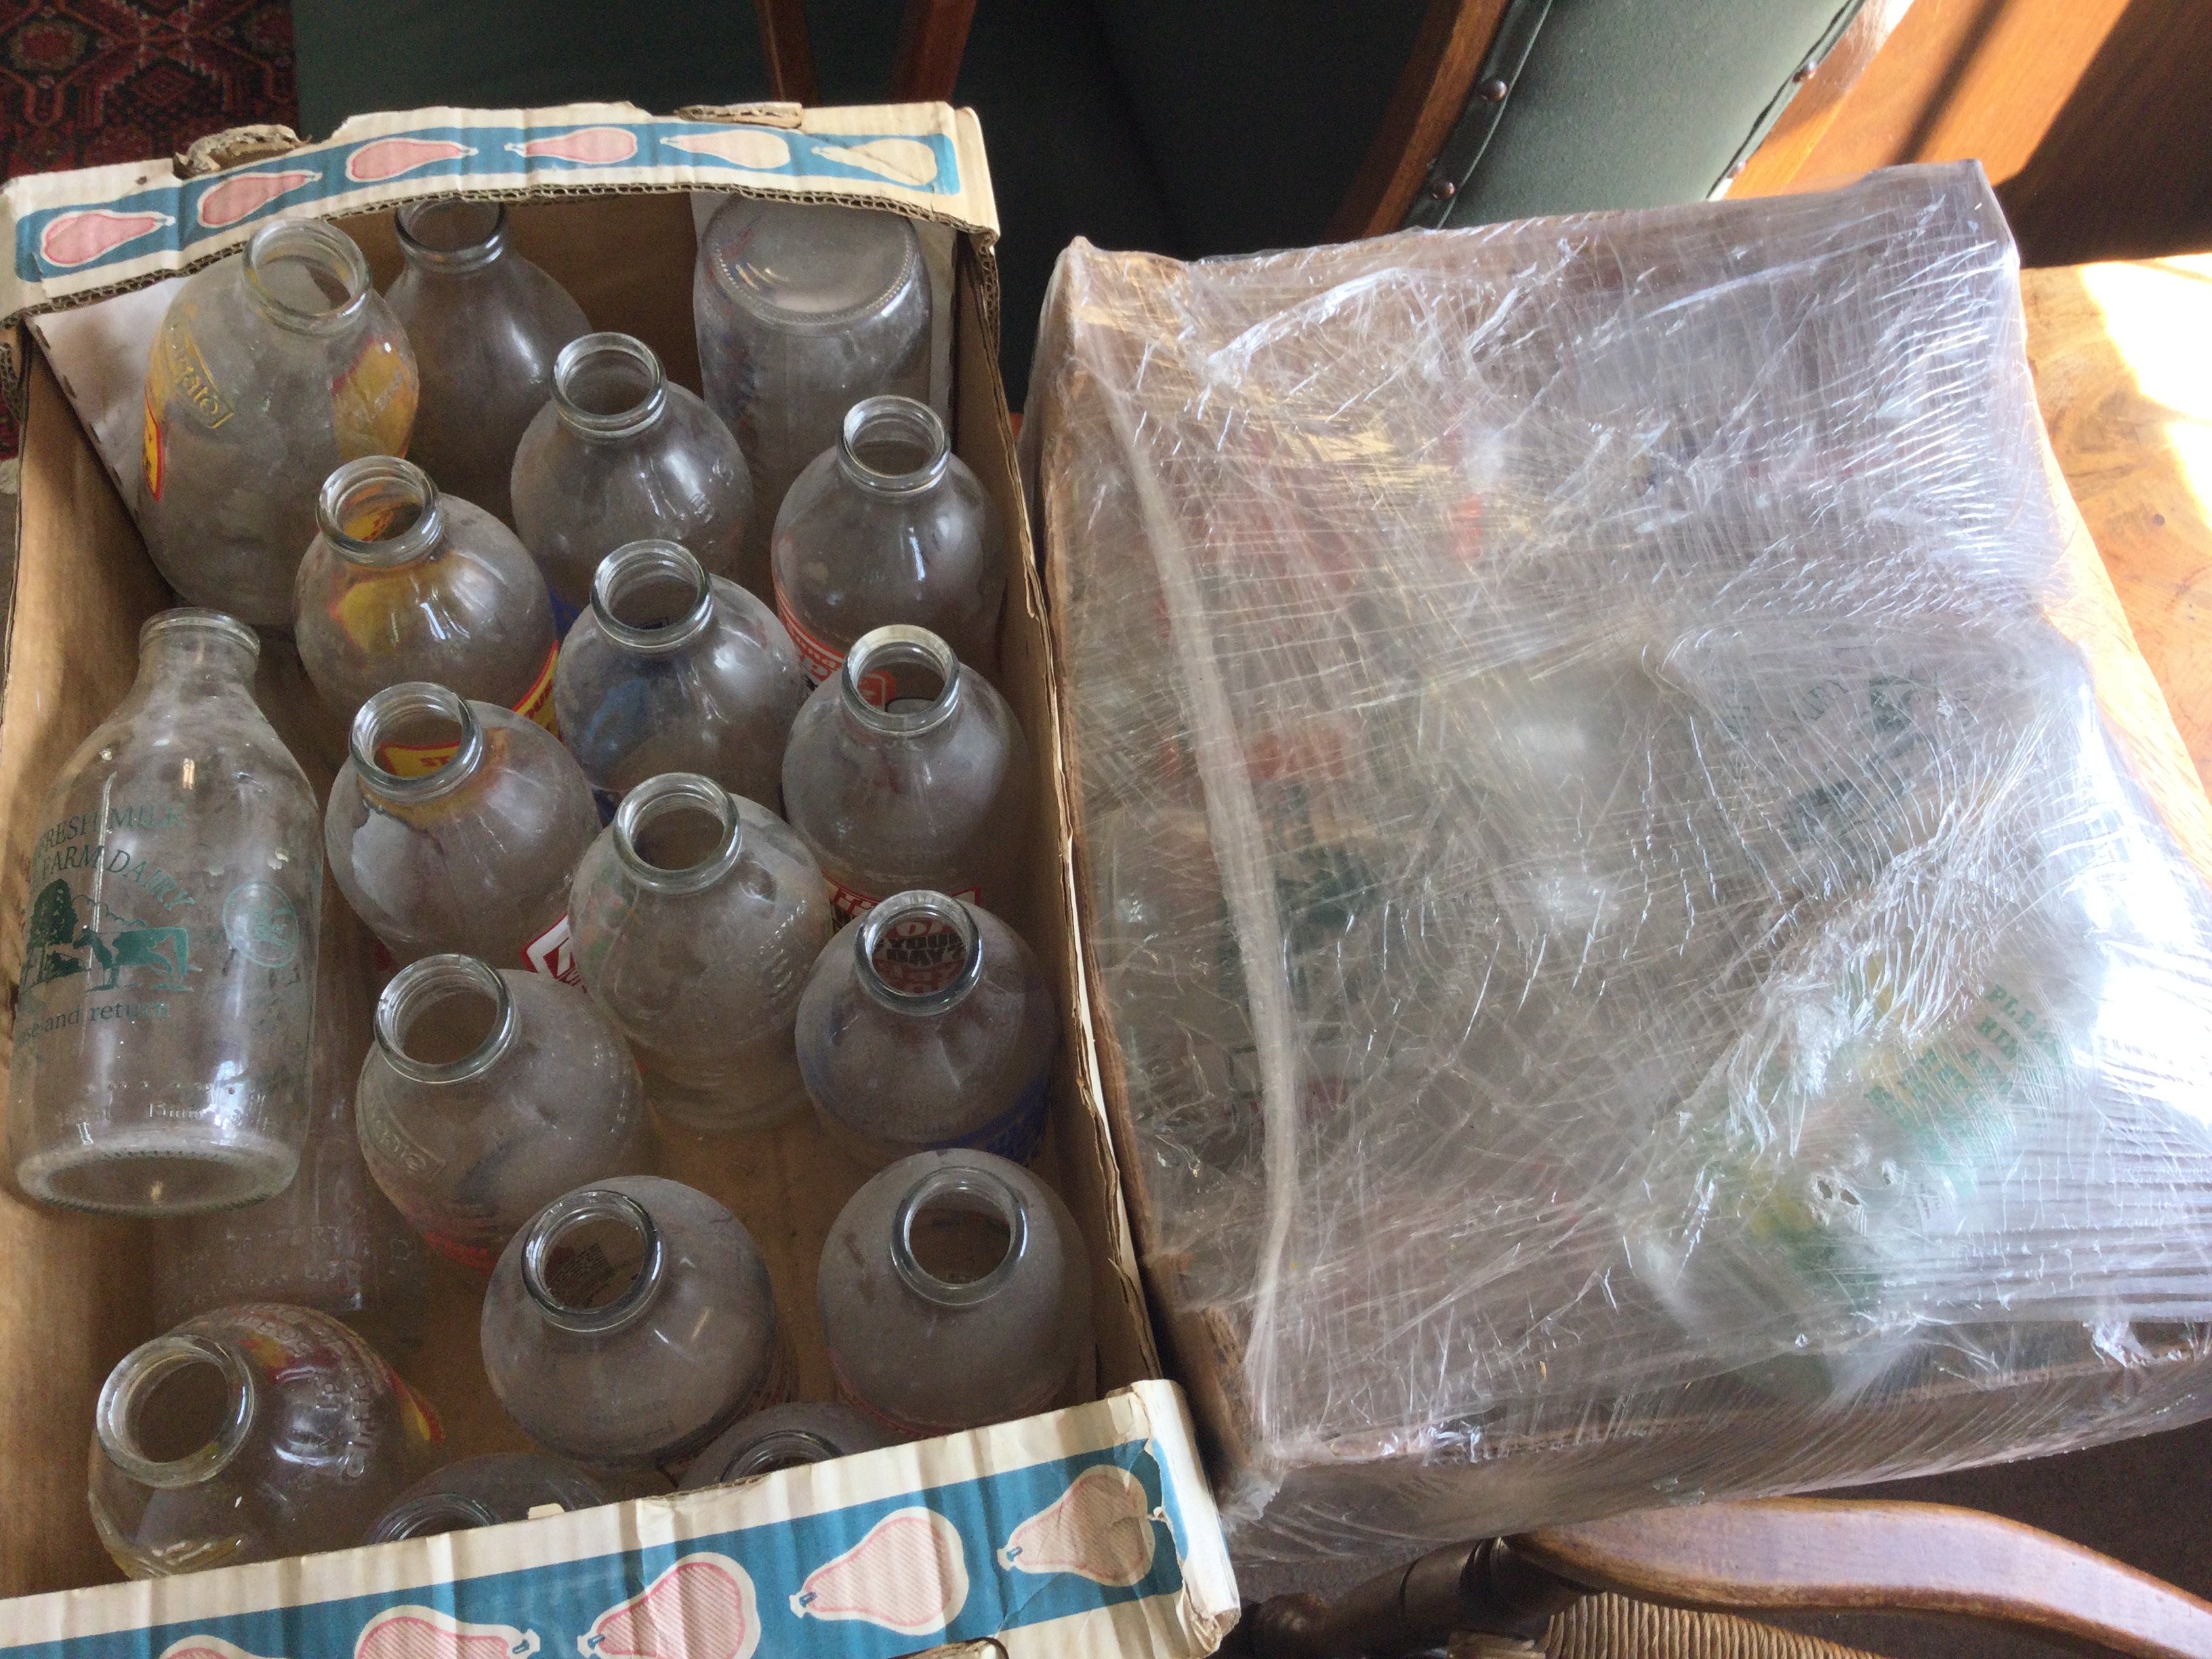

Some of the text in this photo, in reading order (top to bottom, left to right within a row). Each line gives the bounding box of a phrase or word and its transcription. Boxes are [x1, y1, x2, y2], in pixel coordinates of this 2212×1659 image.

[108, 802, 186, 829] MILK
[42, 844, 196, 911] FARM DAIRY
[44, 1004, 81, 1033] and
[89, 1002, 169, 1023] return
